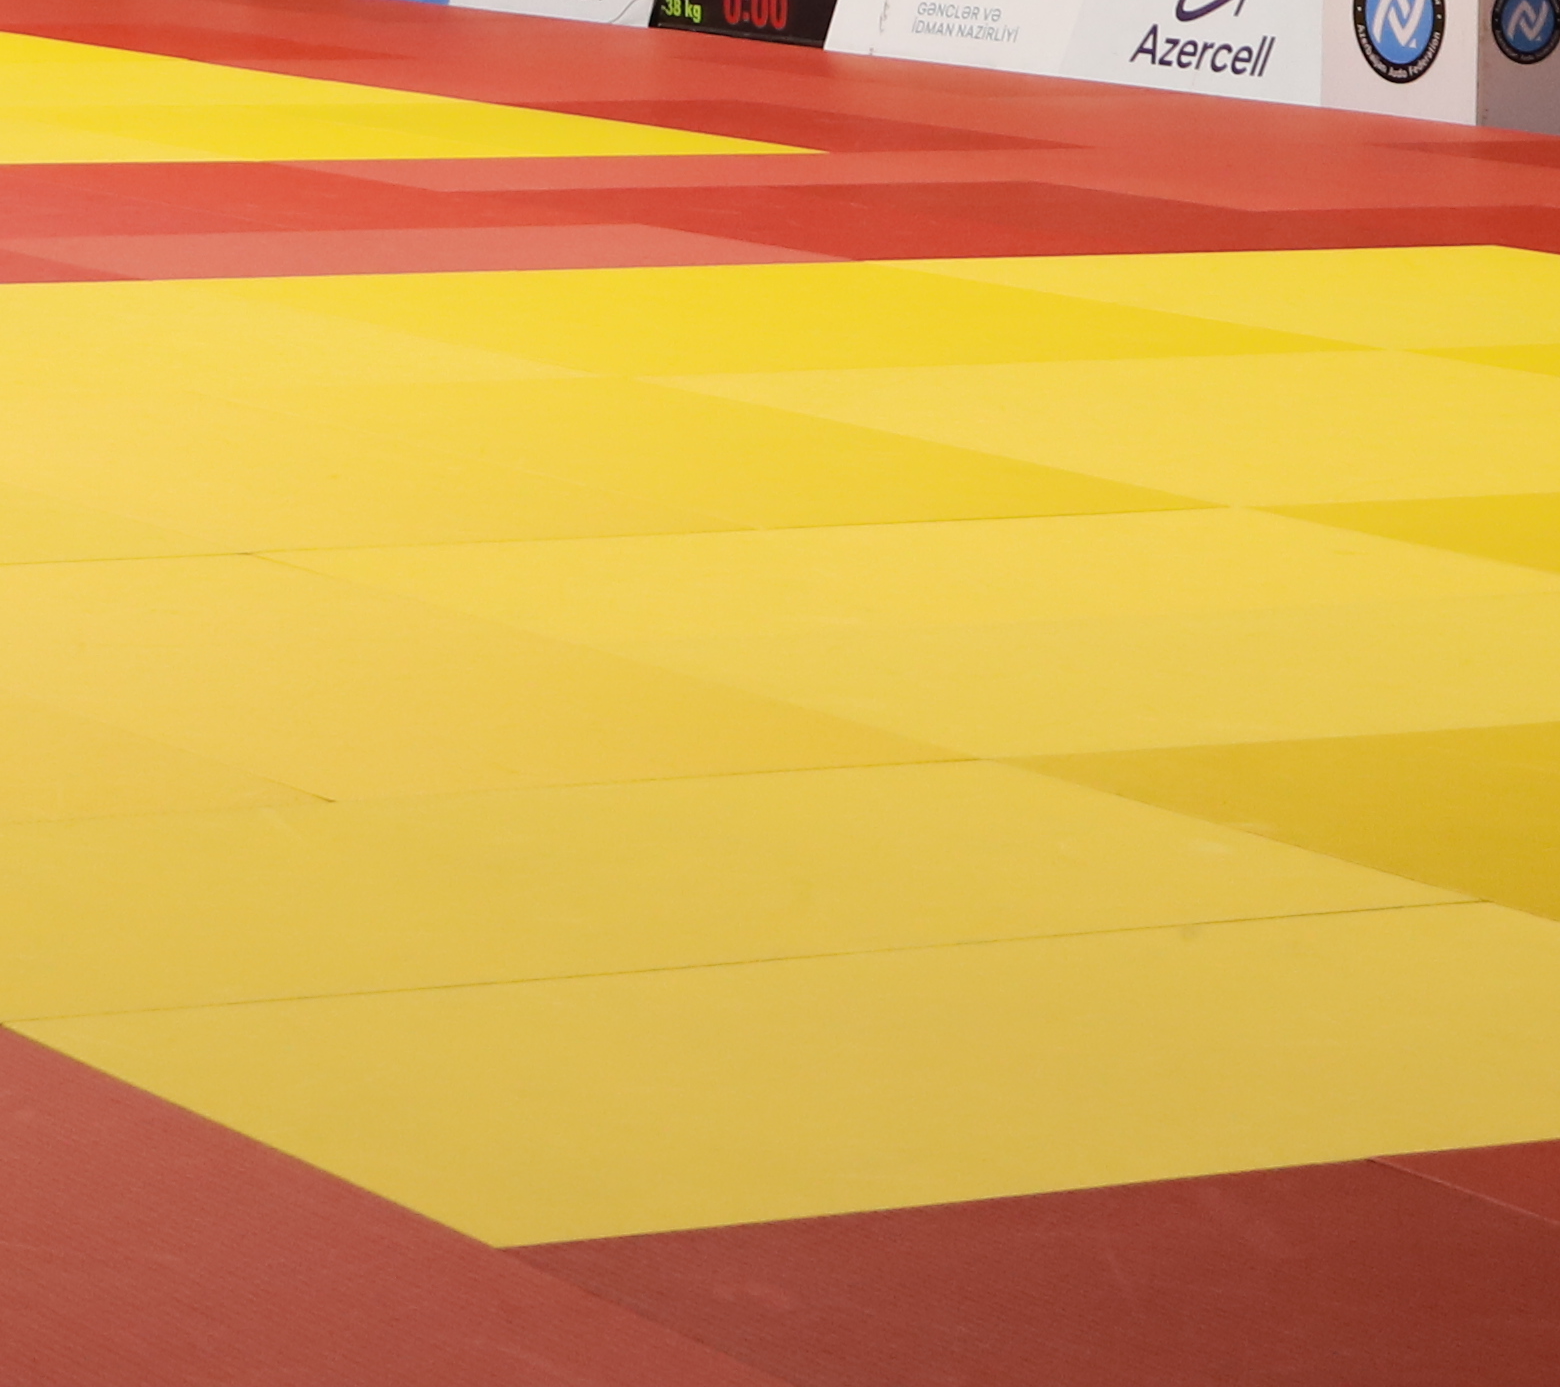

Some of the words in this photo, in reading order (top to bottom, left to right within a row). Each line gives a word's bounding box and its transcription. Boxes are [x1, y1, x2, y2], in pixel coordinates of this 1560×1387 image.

[917, 1, 980, 21] GƏNCLƏR
[983, 7, 1002, 23] VƏ
[911, 16, 954, 38] İDMAN
[1130, 23, 1276, 78] Azercell
